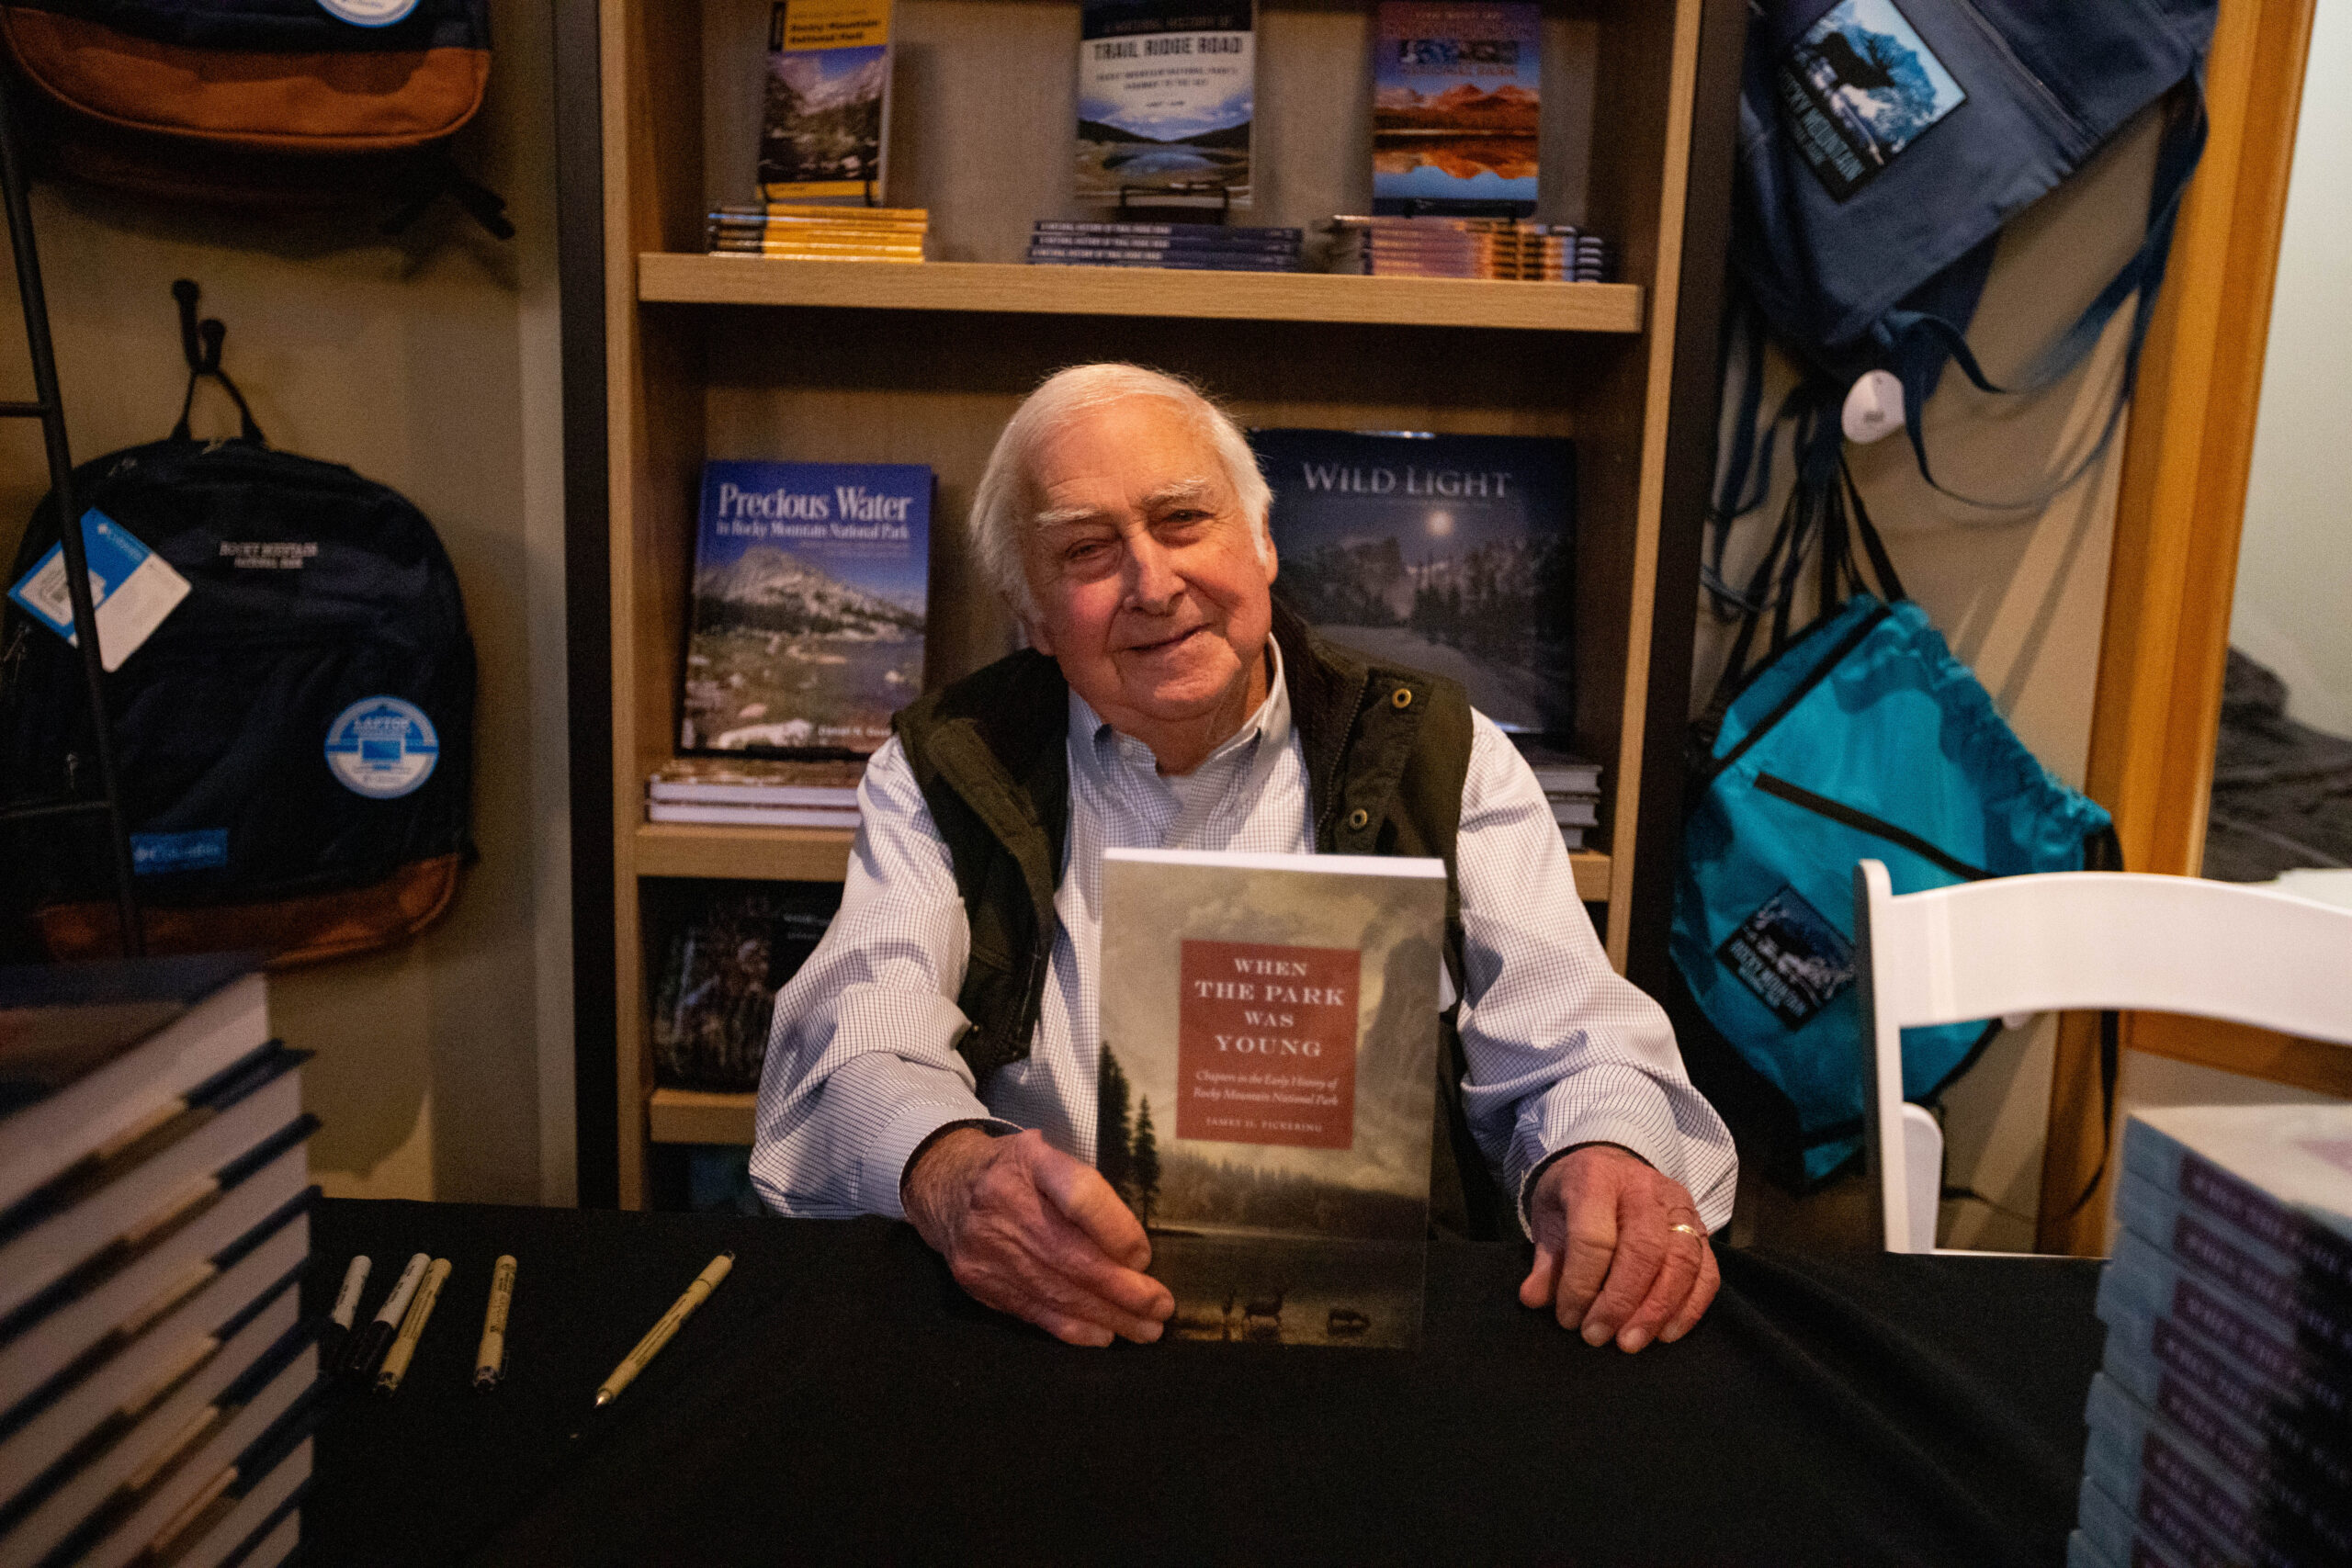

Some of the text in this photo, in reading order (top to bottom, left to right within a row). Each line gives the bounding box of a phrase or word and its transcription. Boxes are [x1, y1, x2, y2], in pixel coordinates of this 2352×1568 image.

[1095, 37, 1241, 59] TRAIL RIDGE ROAD
[1302, 461, 1511, 498] WILD LIGHT
[718, 482, 912, 521] Precious Water
[770, 521, 827, 538] Mountain
[829, 522, 877, 539] National
[881, 522, 910, 540] Park
[1234, 957, 1307, 976] WHEN
[1194, 980, 1346, 1007] THE PARK
[1244, 1010, 1295, 1028] WAS
[1215, 1034, 1322, 1057] YOUNG
[1193, 1086, 1340, 1106] Rocky Mountain National Park
[1205, 1116, 1240, 1127] JAMES
[1261, 1120, 1323, 1133] PICKERING
